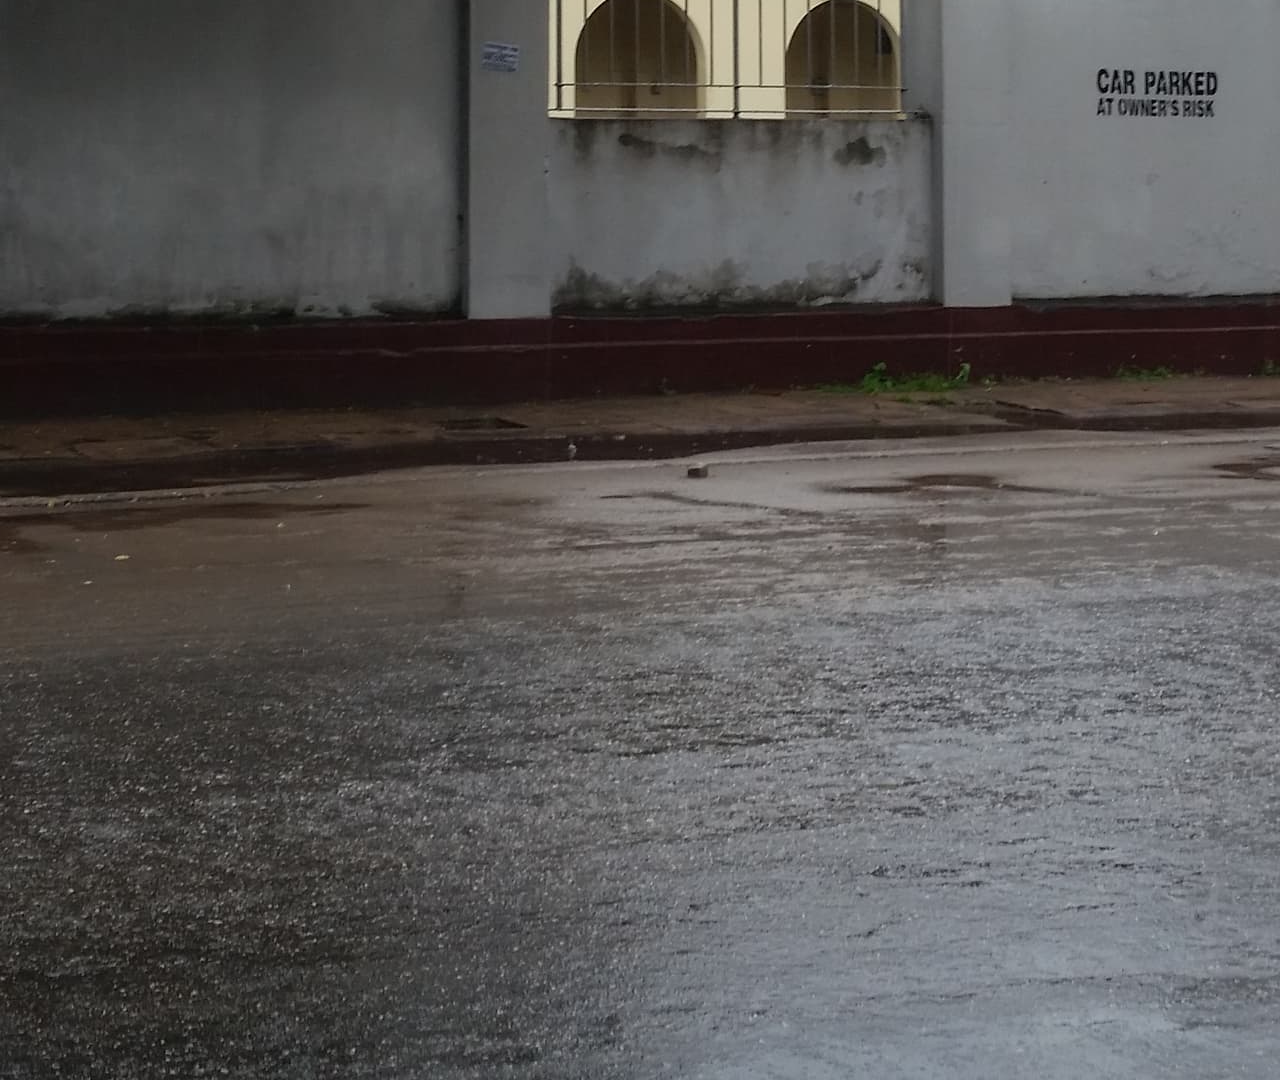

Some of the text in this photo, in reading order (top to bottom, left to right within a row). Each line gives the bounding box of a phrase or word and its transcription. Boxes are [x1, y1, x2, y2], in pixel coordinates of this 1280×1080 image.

[1096, 68, 1218, 96] CAR PARKED
[1096, 97, 1216, 118] AT OWNER'S RISK
